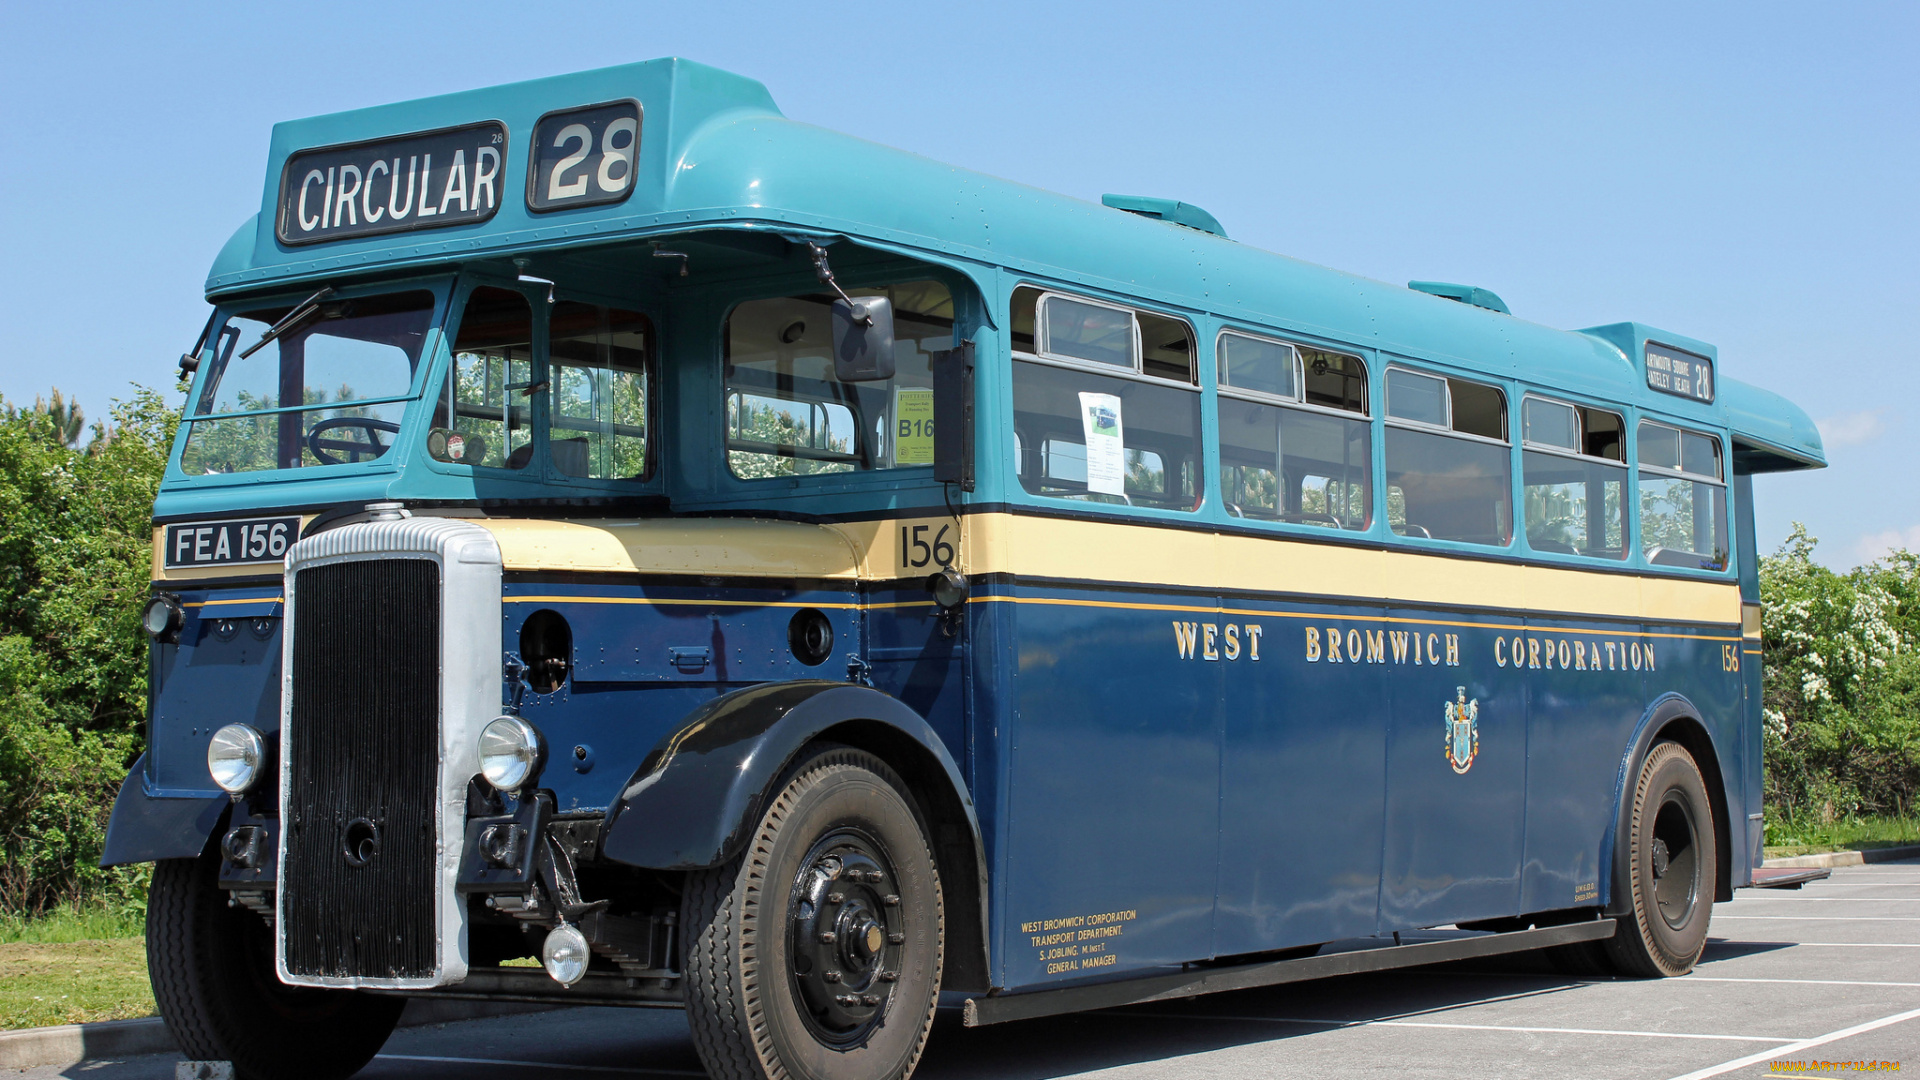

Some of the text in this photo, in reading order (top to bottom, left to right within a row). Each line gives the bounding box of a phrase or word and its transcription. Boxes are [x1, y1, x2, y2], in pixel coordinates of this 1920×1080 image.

[492, 134, 503, 144] 28
[548, 117, 637, 200] 28
[299, 146, 501, 231] CIRCULAR
[1673, 360, 1690, 376] SQUARE
[1674, 376, 1690, 394] HEATH
[1696, 364, 1709, 400] 28
[899, 419, 935, 437] B16
[175, 523, 288, 563] FEA 156
[902, 524, 954, 567] 156
[1173, 621, 1655, 672] WEST BROMWICH CORPORATION
[1722, 645, 1739, 672] 156
[1021, 910, 1136, 933] WEST BROMWICH CORPORATION
[1031, 932, 1075, 947] TRANSPORT
[1047, 954, 1117, 974] GENERAL MANAGER
